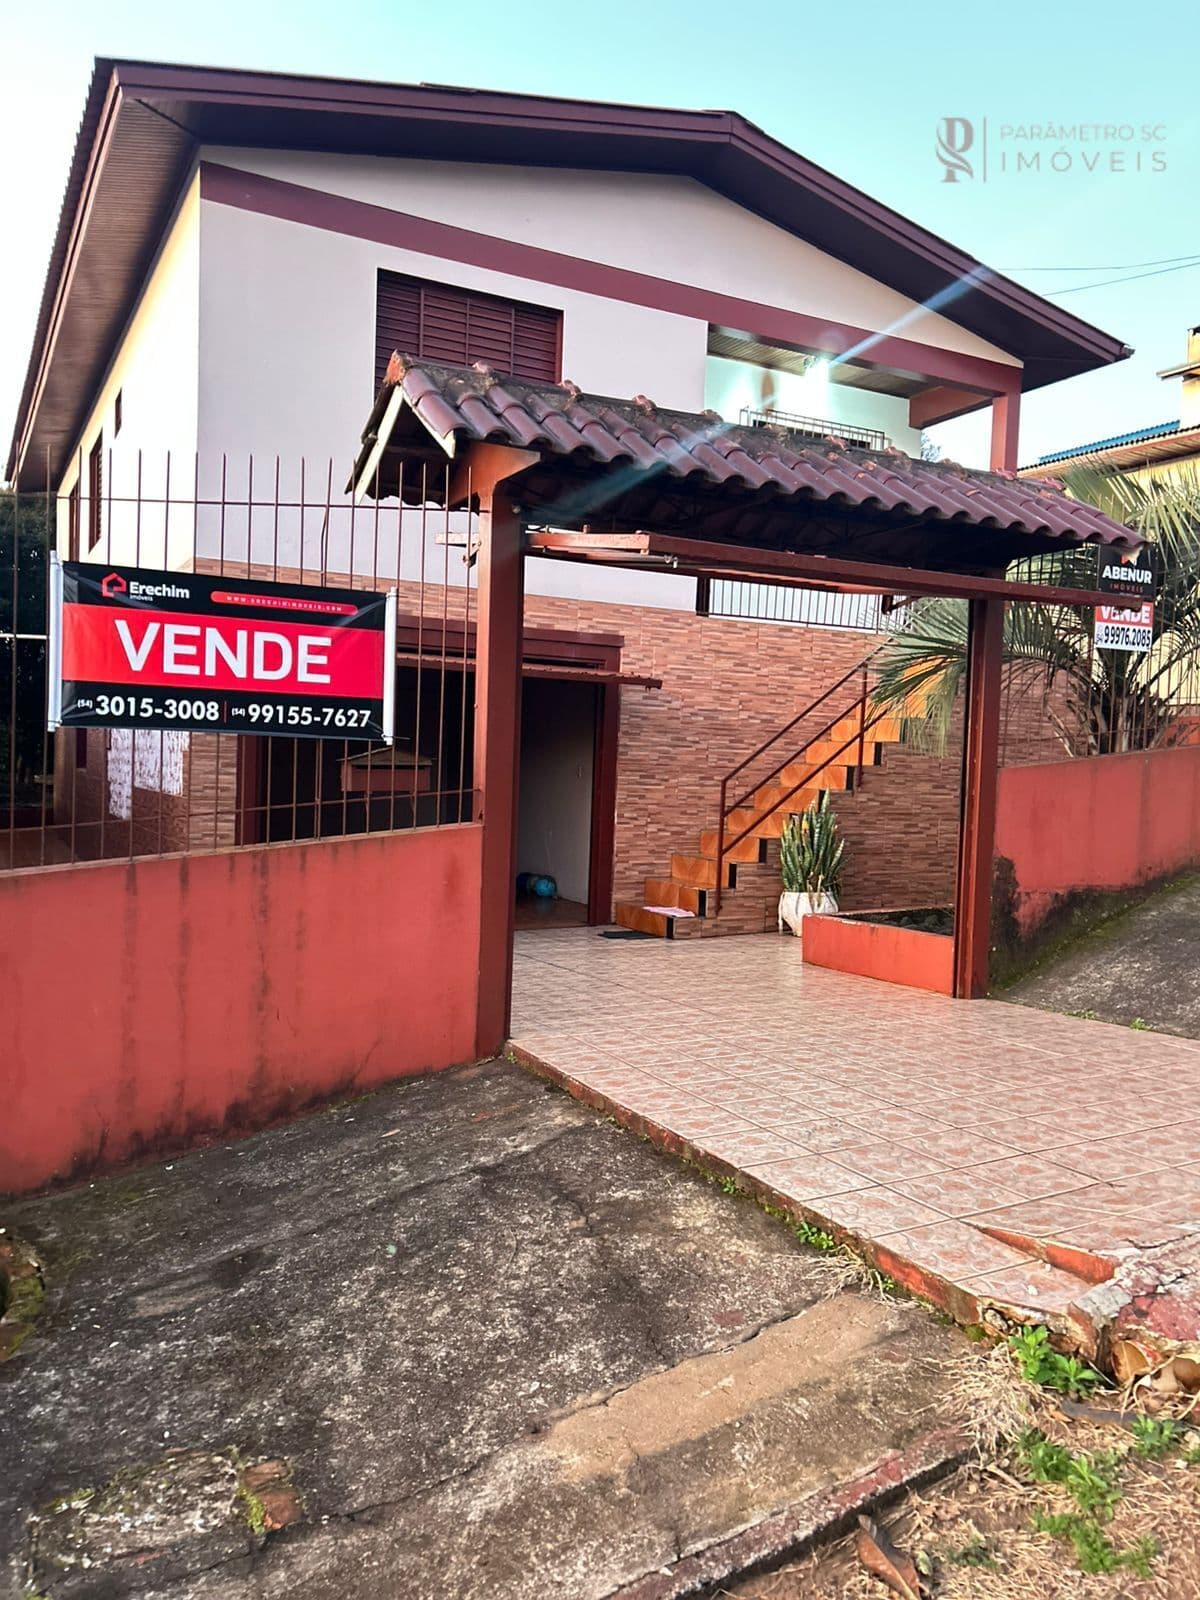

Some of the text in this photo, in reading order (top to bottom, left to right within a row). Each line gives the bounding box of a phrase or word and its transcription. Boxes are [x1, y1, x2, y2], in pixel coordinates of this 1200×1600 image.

[1102, 565, 1152, 584] ABENUR
[129, 581, 190, 599] Erechim
[114, 619, 332, 684] VENDE
[77, 695, 371, 728] (54) 3015-3008 (54) 99155-7627
